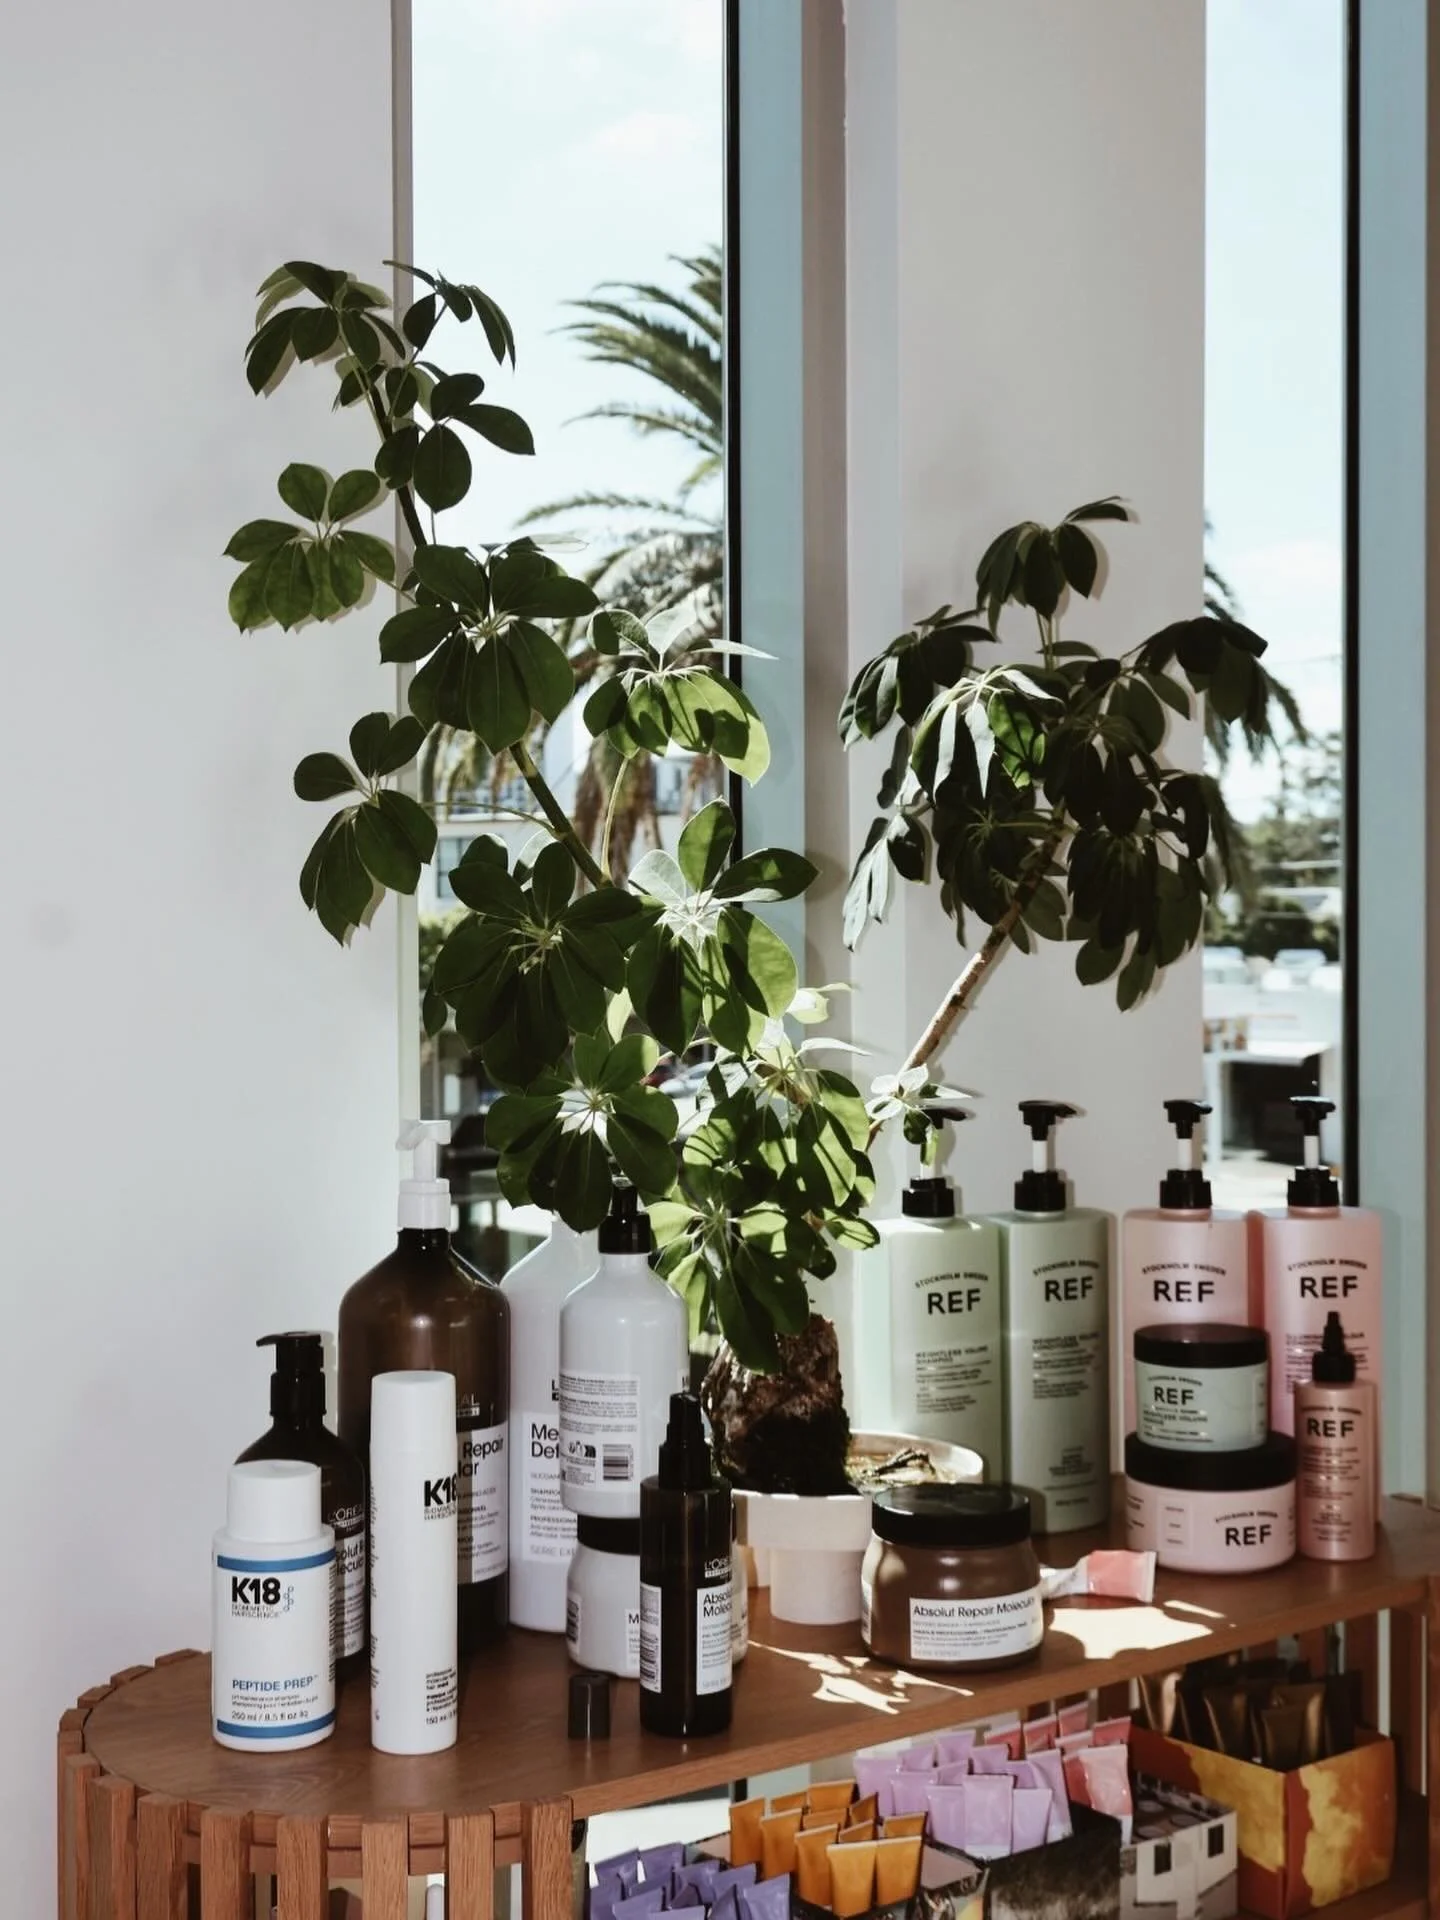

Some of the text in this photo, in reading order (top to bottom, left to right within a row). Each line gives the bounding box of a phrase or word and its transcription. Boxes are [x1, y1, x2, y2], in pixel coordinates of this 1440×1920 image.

[1033, 1260, 1076, 1276] STOCKHOLM
[1142, 1263, 1190, 1275] STOCKHOLM
[915, 1272, 960, 1288] STOCKHOLM
[1045, 1276, 1093, 1302] REF
[1300, 1275, 1358, 1298] REF
[928, 1288, 981, 1315] REF
[1154, 1280, 1214, 1302] REF
[1154, 1386, 1194, 1405] REF
[532, 1423, 560, 1441] Me
[1307, 1417, 1354, 1438] REF
[463, 1434, 504, 1460] Repair
[1226, 1525, 1272, 1546] REF
[232, 1576, 281, 1605] K18
[913, 1605, 954, 1617] Absolut
[958, 1606, 994, 1618] Repair
[232, 1679, 281, 1691] PEPTIDE
